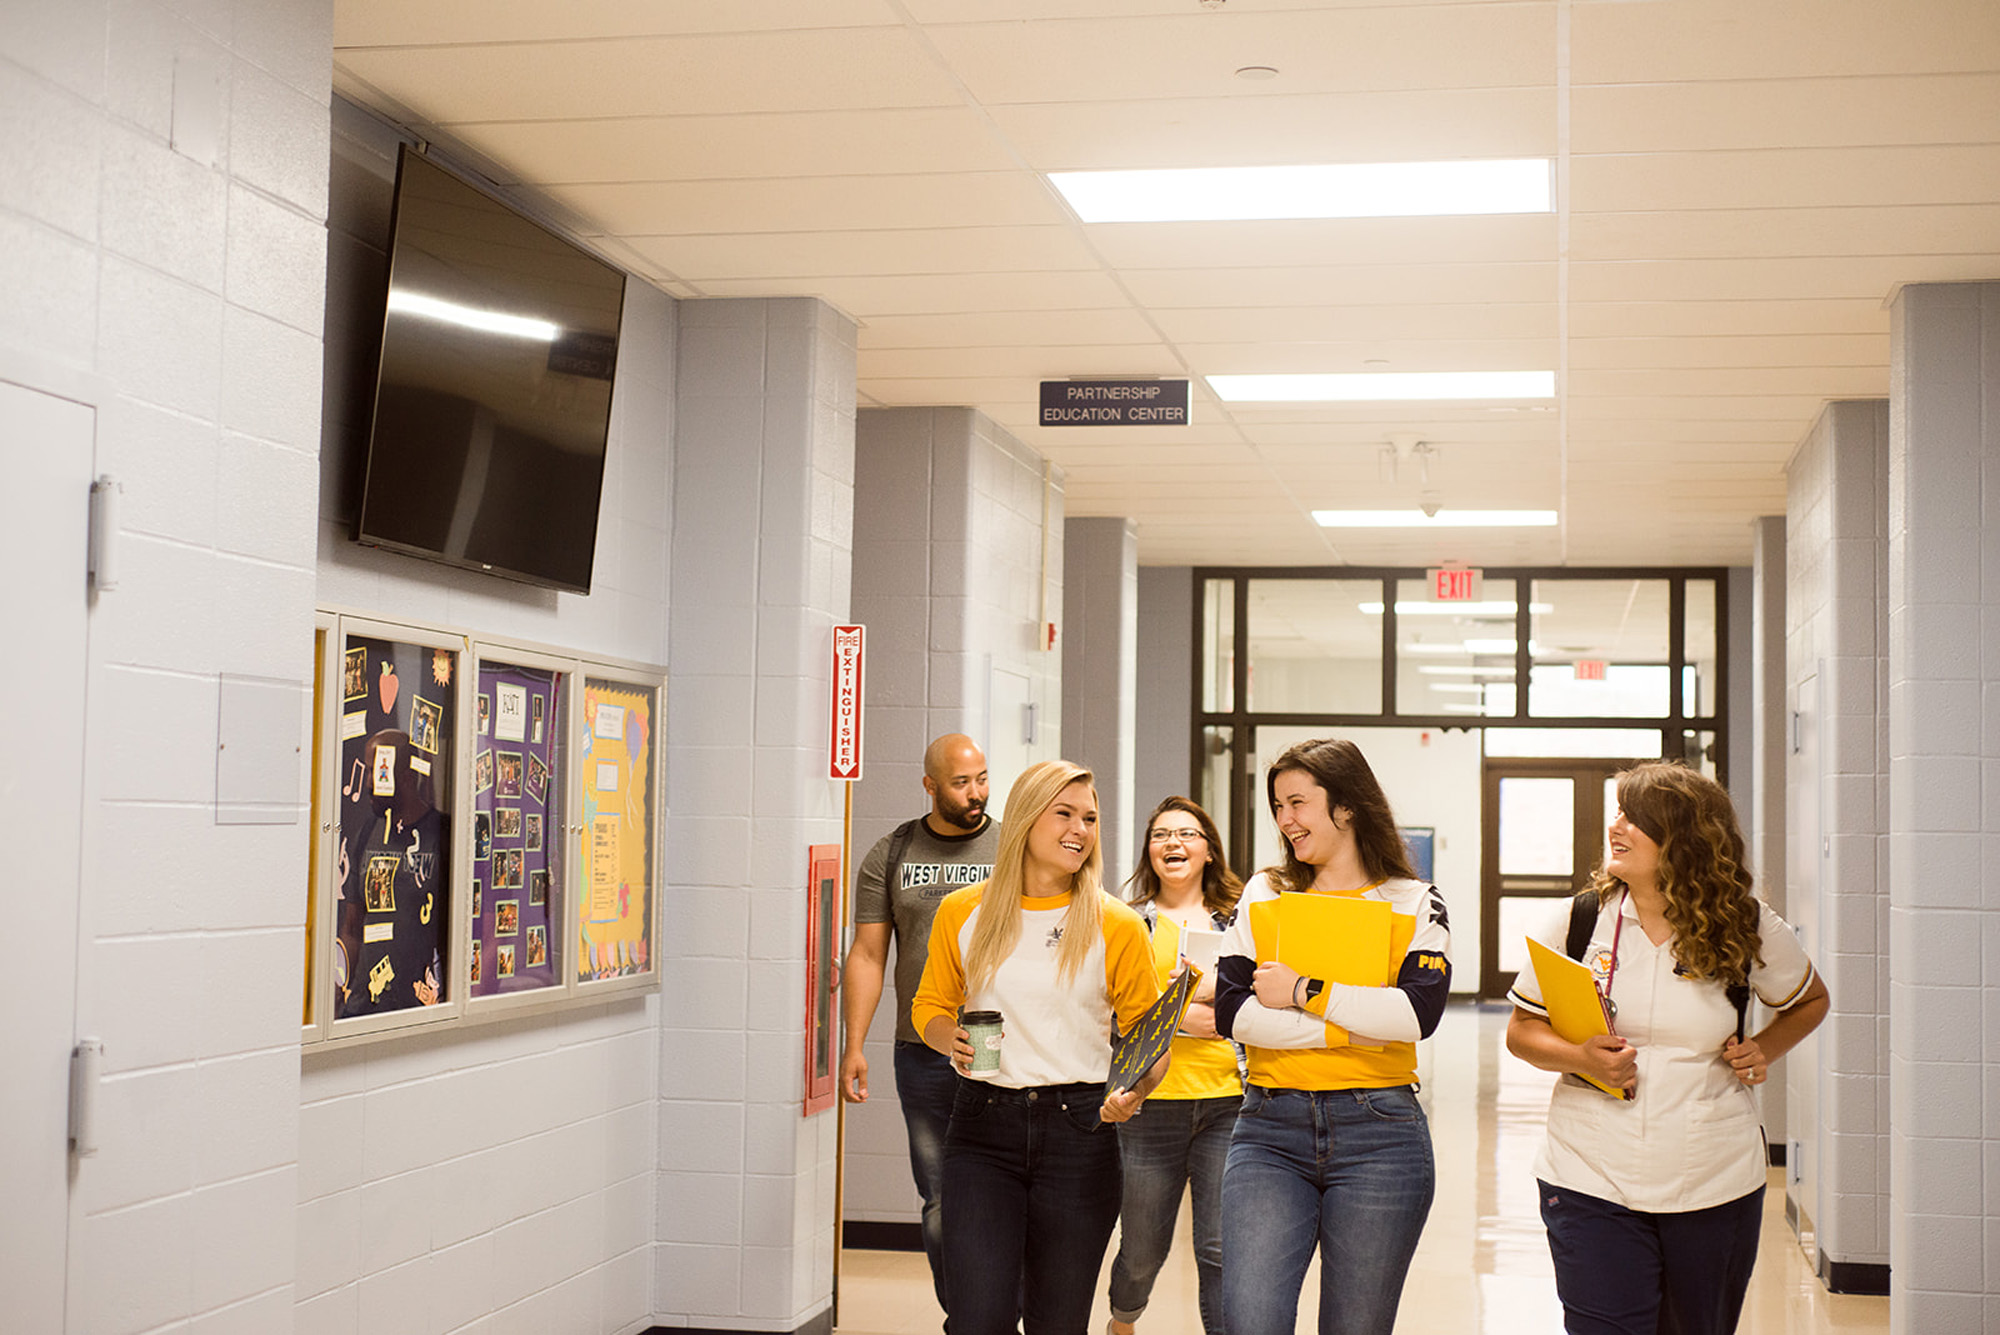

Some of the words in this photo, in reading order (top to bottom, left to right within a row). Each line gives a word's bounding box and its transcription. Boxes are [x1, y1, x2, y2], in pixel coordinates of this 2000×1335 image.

[1067, 387, 1161, 400] PARTNERSHIP
[1044, 408, 1121, 421] EDUCATION
[1128, 407, 1184, 420] CENTER
[1437, 570, 1475, 600] EXIT
[837, 635, 859, 647] FIRE
[841, 648, 852, 766] EXTINGUISHER
[900, 863, 941, 891] WEST
